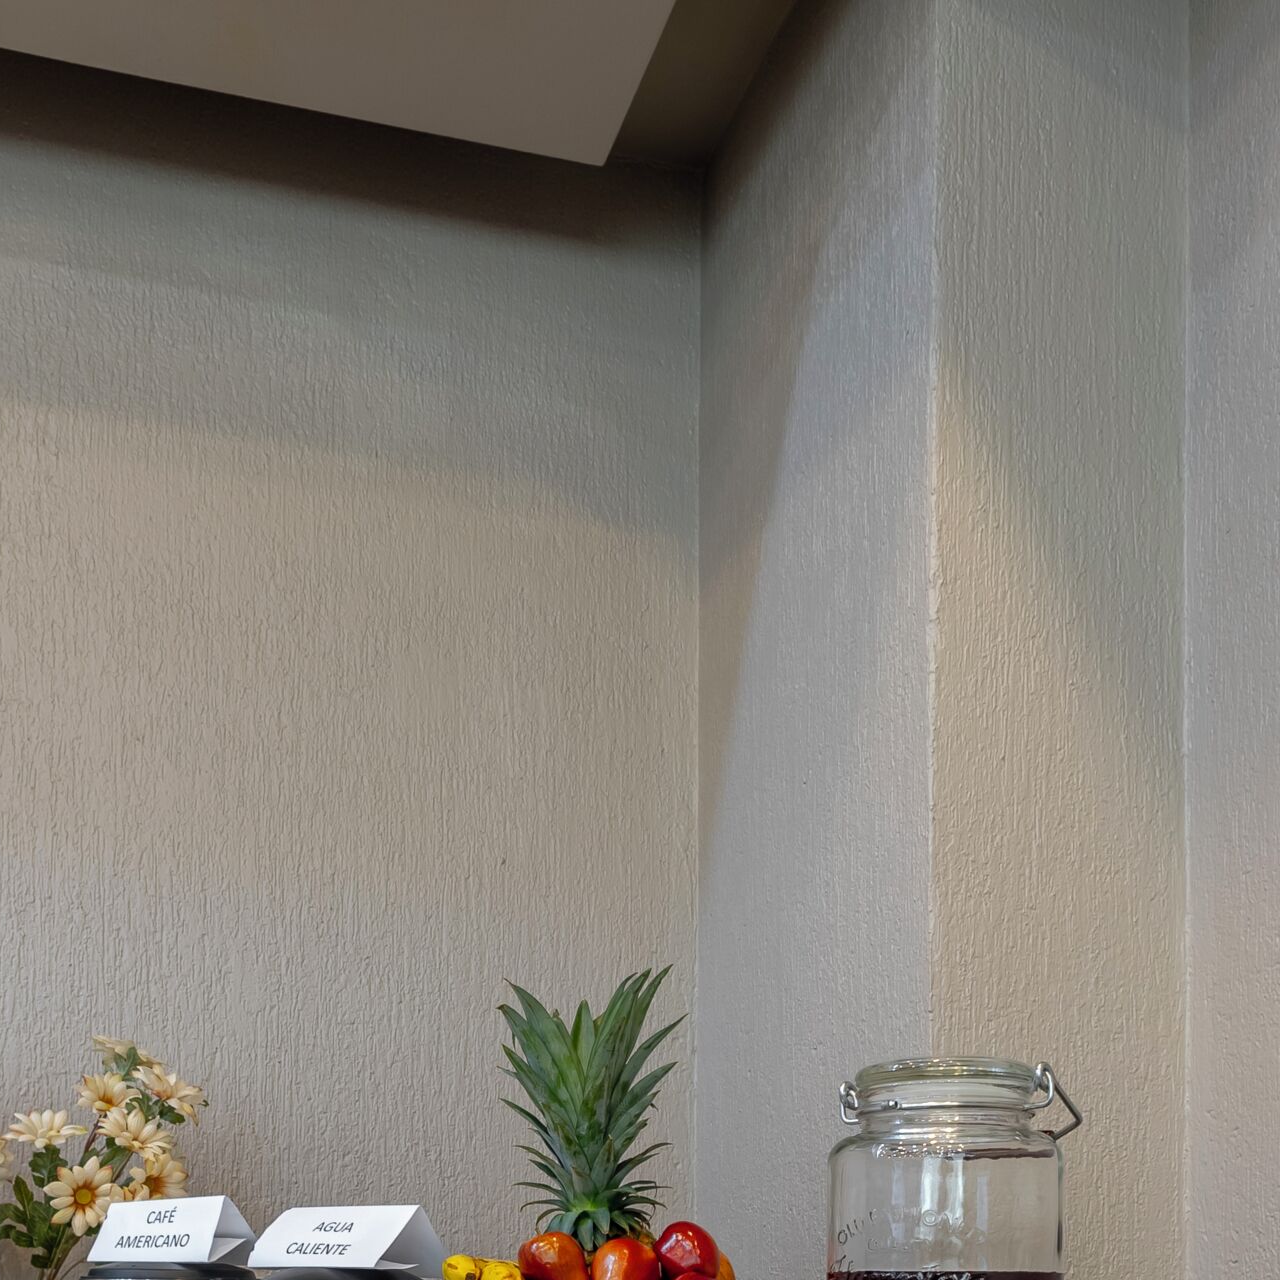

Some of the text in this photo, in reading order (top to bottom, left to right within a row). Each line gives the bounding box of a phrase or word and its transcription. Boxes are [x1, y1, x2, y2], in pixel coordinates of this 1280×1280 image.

[146, 1206, 177, 1224] CAFÉ
[312, 1221, 354, 1233] AGUA
[114, 1233, 190, 1249] AMERICANO
[286, 1242, 352, 1255] CALIENTE
